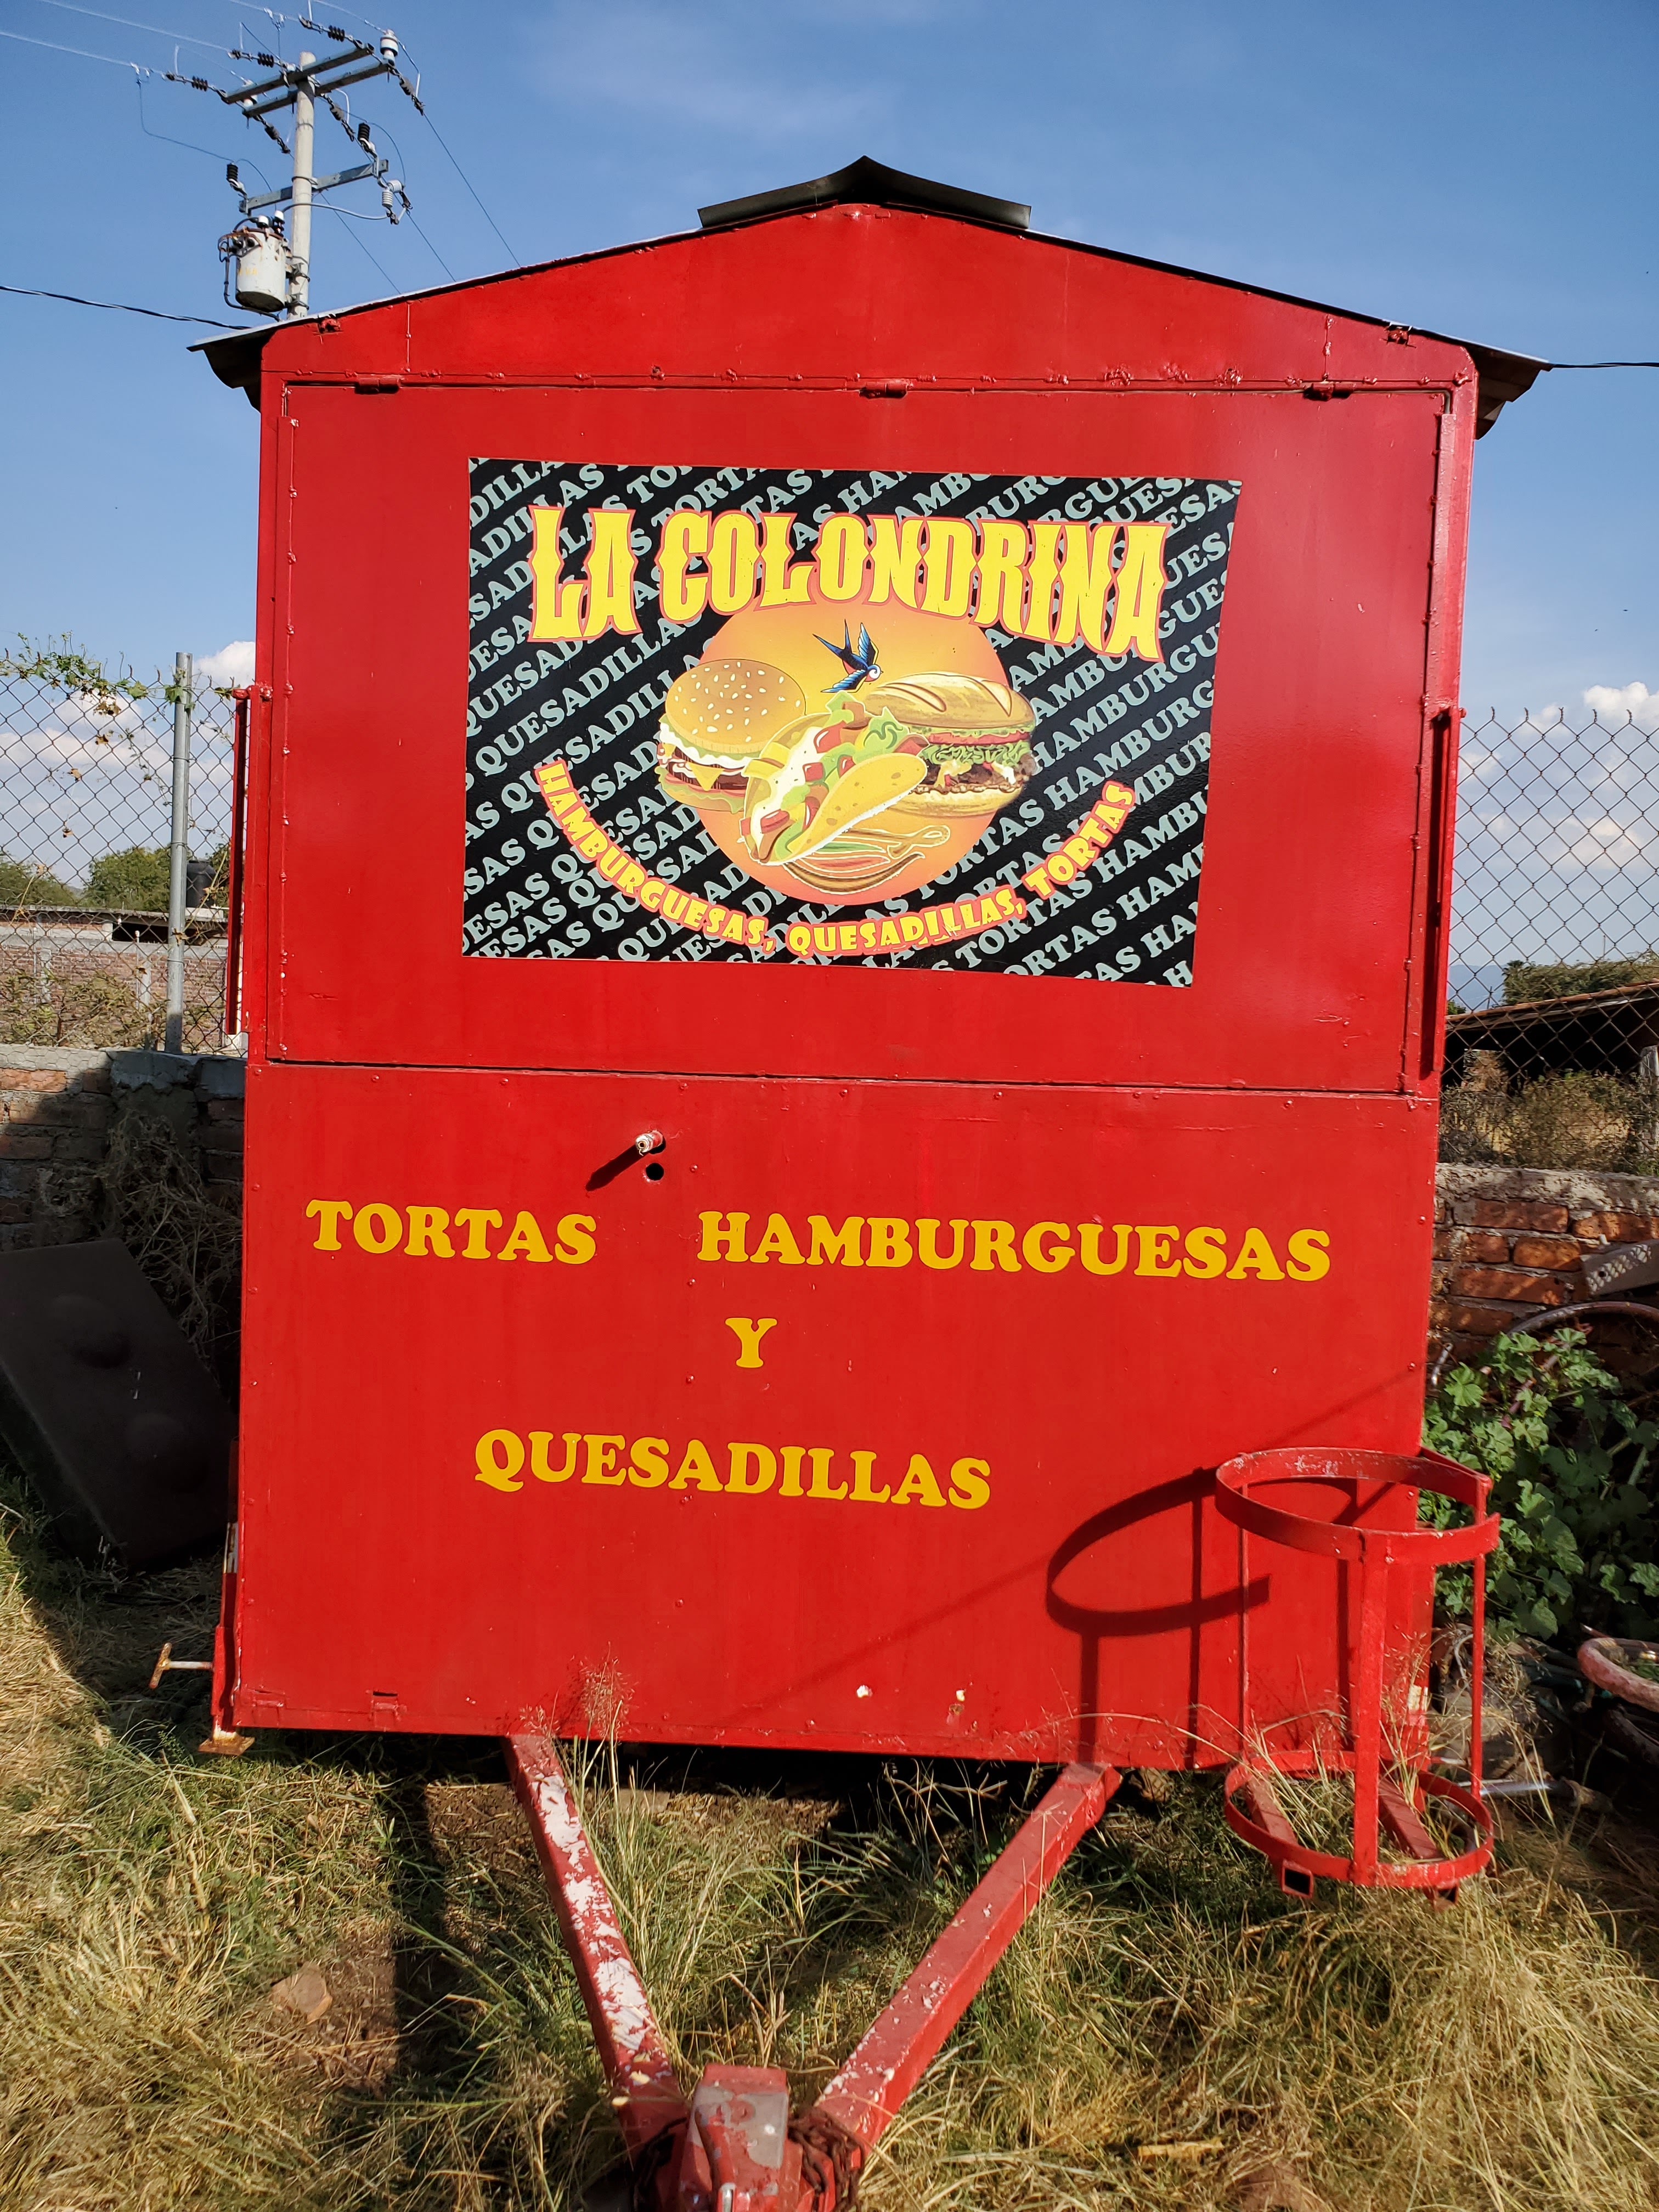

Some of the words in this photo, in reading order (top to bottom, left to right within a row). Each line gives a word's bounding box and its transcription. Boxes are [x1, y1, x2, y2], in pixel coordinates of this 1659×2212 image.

[529, 506, 639, 641] LA
[475, 614, 703, 777] QUESADILLA
[1032, 625, 1218, 776] HAMBURGU
[1042, 679, 1214, 811] HAMBURG
[538, 761, 775, 952] HAMBURGUESAS,
[787, 887, 1024, 957] QUESADILLAS,
[1024, 784, 1133, 897] TORTAS
[472, 896, 568, 958] ESAS
[954, 871, 1093, 969] TORTAS
[306, 1200, 596, 1265] TORTAS
[697, 1211, 1330, 1282] HAMBURGUESAS
[725, 1317, 777, 1368] Y
[475, 1429, 990, 1509] QUESADILLAS
